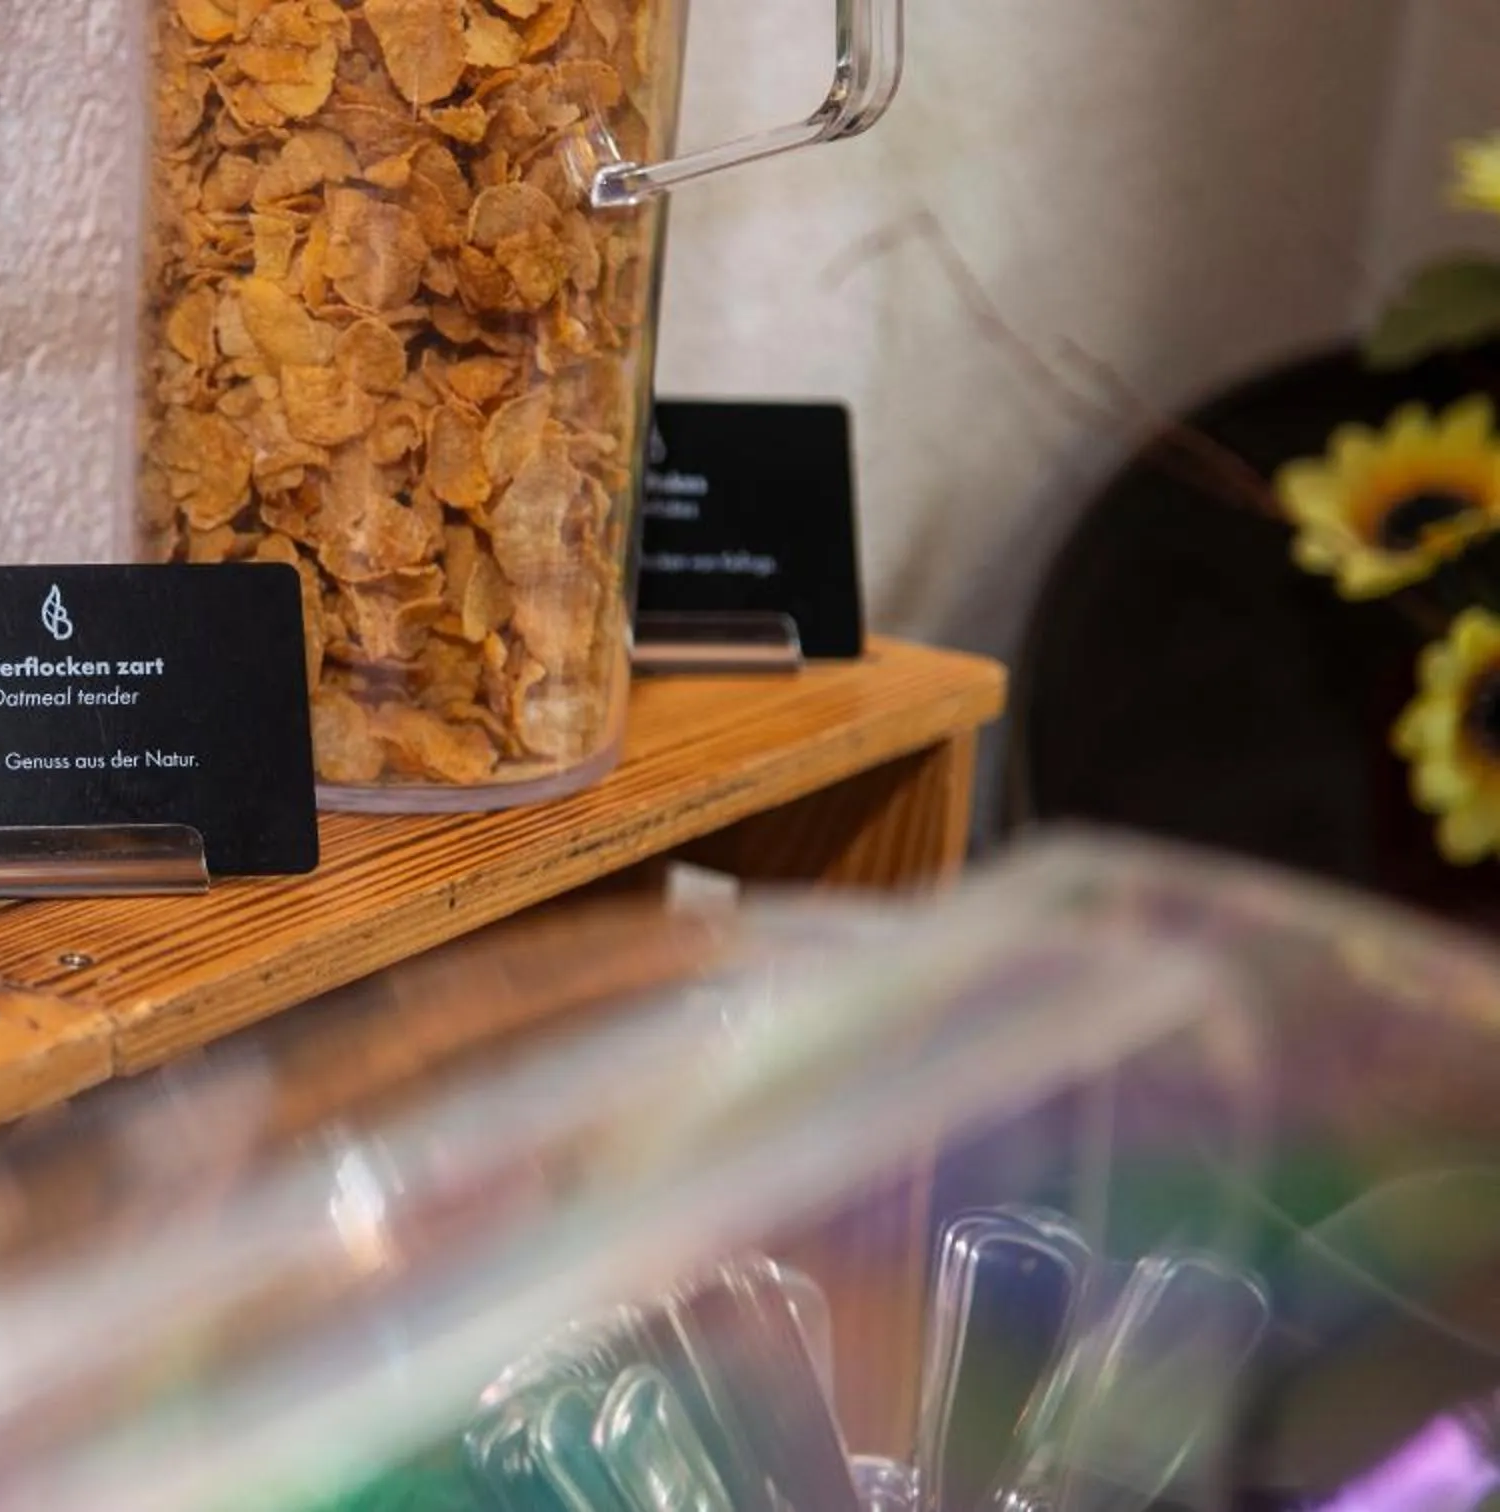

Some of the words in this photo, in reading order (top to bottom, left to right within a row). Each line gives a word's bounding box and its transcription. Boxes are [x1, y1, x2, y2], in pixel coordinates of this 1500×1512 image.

[116, 657, 165, 676] zart
[77, 685, 140, 706] tender
[4, 751, 71, 771] Genuss
[75, 756, 106, 769] aus
[110, 749, 140, 768] der
[145, 749, 199, 768] Natur.
